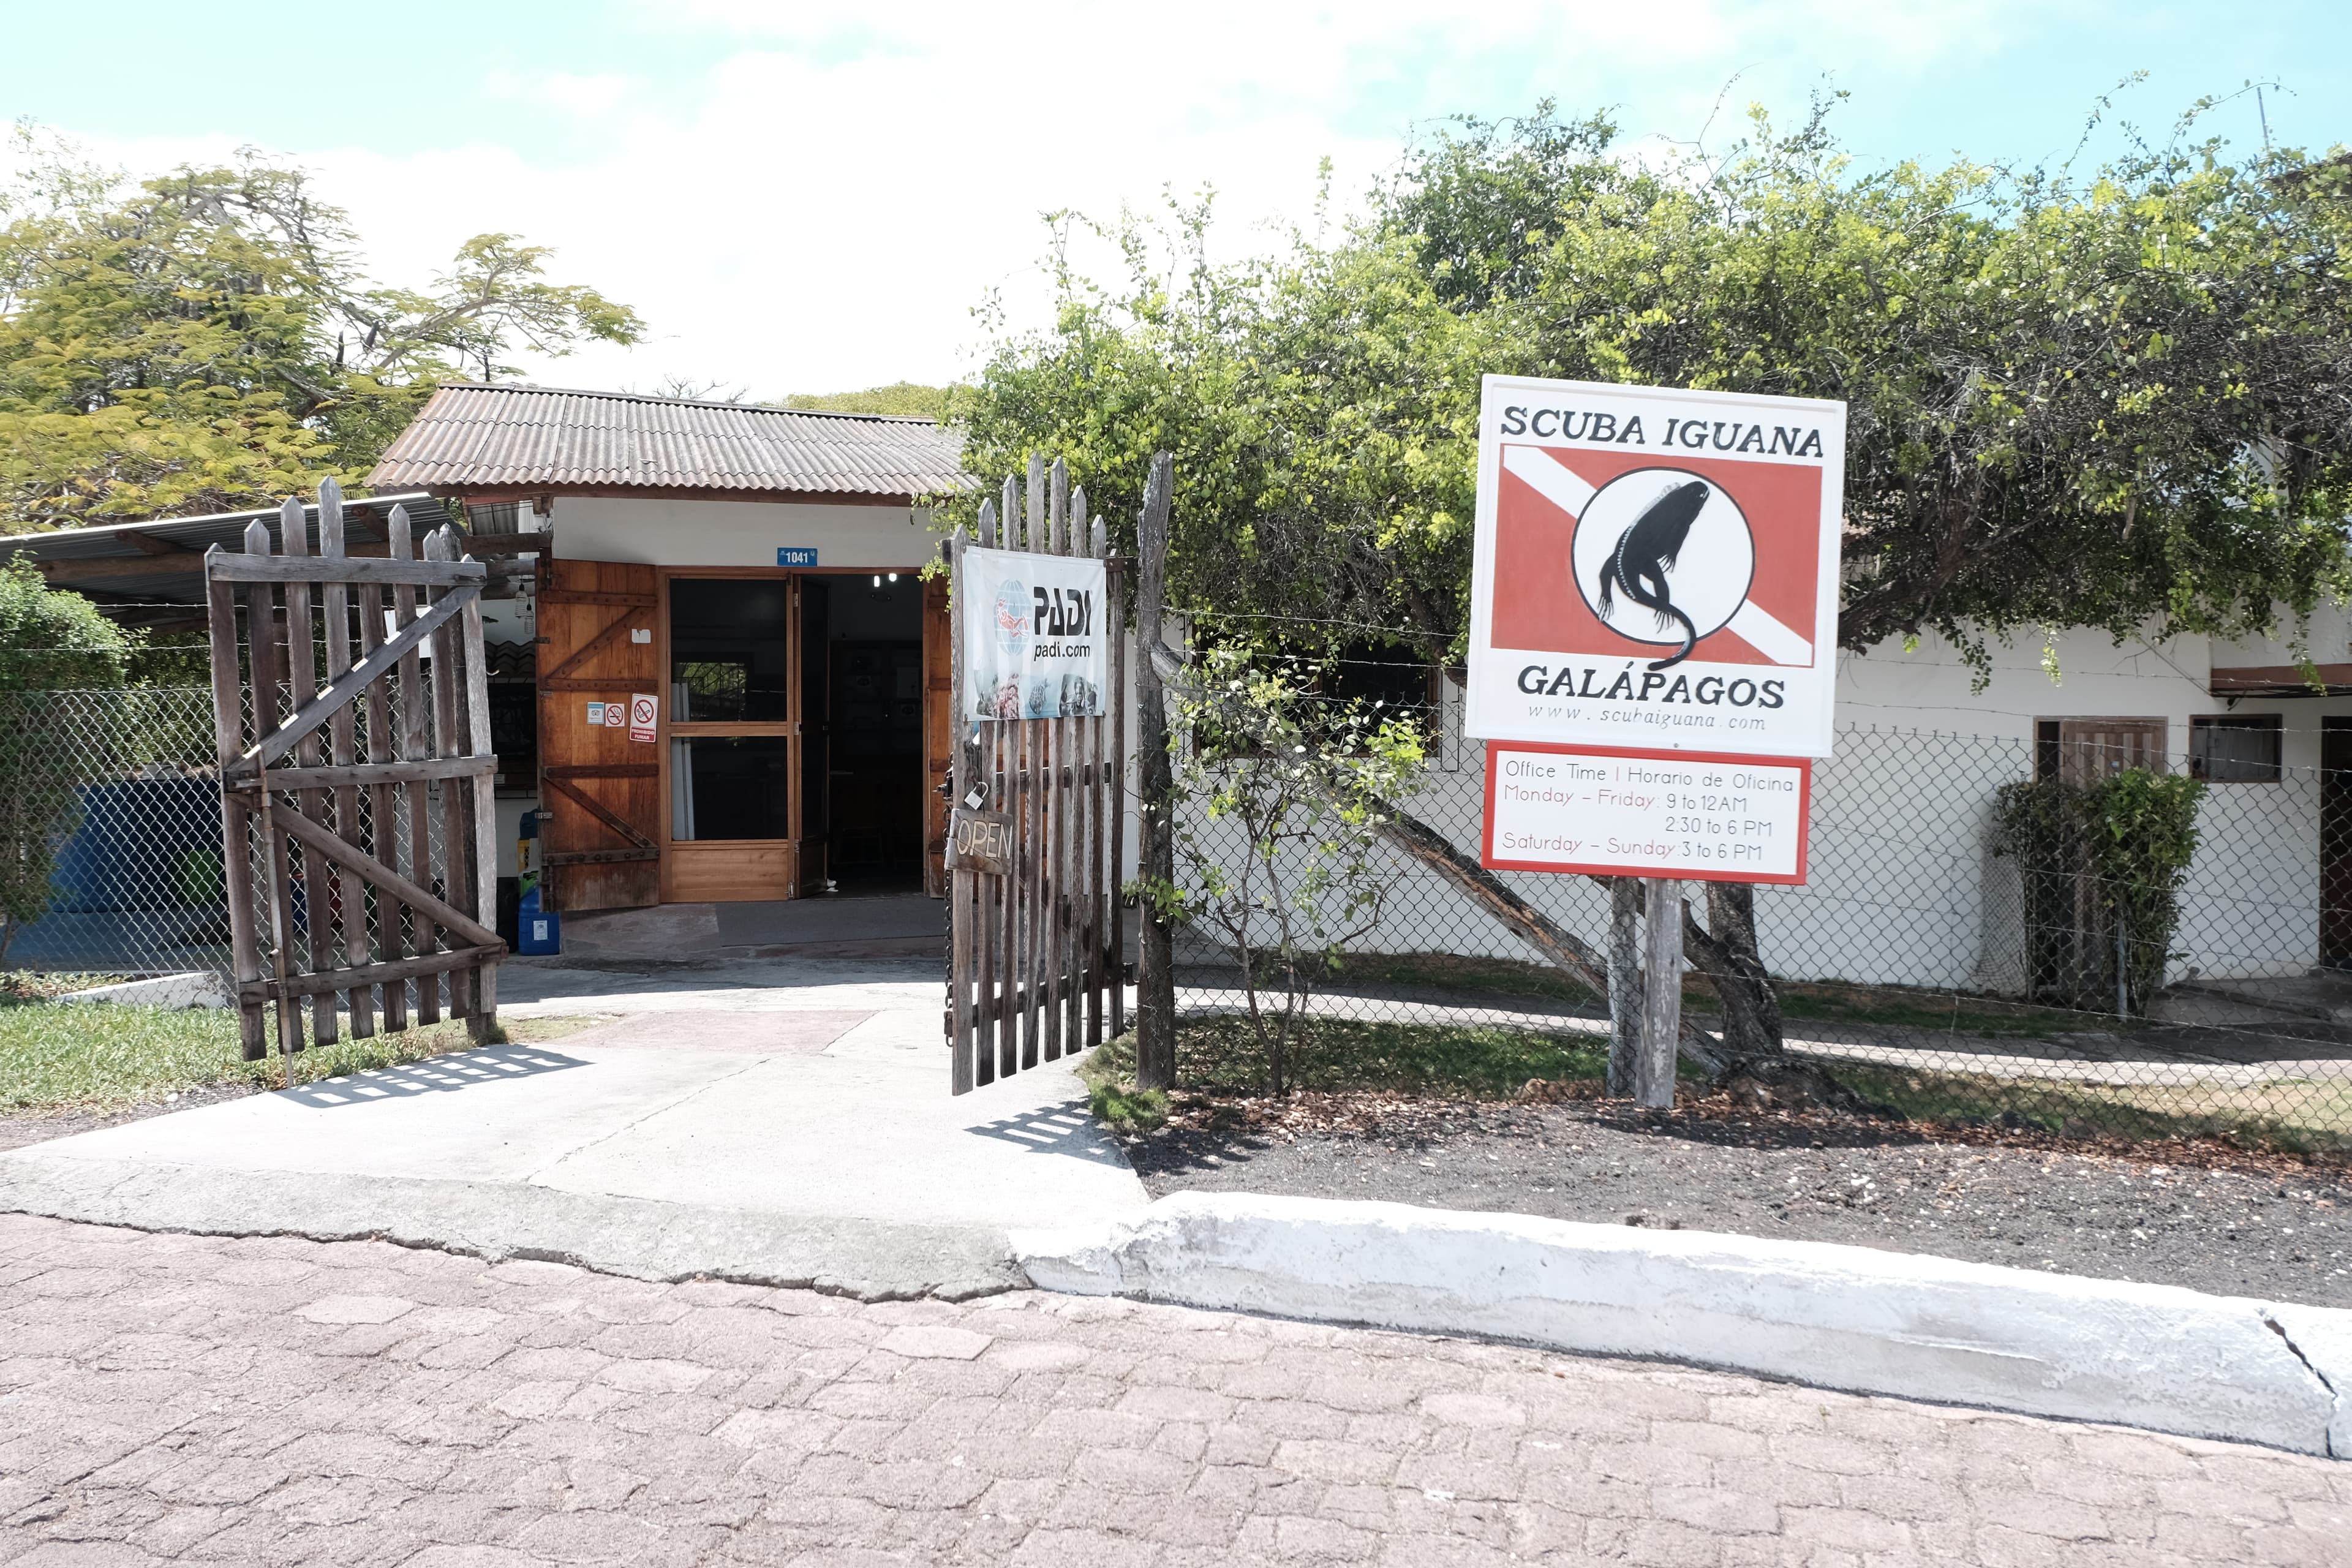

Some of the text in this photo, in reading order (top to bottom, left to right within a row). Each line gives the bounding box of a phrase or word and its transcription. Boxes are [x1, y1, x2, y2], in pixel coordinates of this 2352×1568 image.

[1501, 405, 1824, 458] SCUBA IGUANA
[786, 552, 808, 563] 1041
[1033, 586, 1091, 636] PADI
[1034, 641, 1090, 662] padi.com
[1517, 661, 1784, 709] GALÁPAGOS
[1506, 760, 1556, 778] Office
[1566, 763, 1606, 780] Time
[1628, 766, 1692, 785] Horario
[1702, 772, 1722, 787] de
[1733, 774, 1793, 791] Oficina
[1504, 785, 1574, 807] Monday
[1598, 789, 1660, 811] Friday:
[1666, 793, 1676, 809] 9
[1682, 794, 1696, 810] to
[957, 819, 1013, 859] OPEN
[1665, 816, 1772, 837] 2:30 to 6 PM
[1502, 832, 1583, 855] Saturday
[1697, 842, 1711, 858] to
[1717, 843, 1727, 859] 6
[1733, 844, 1762, 861] PM
